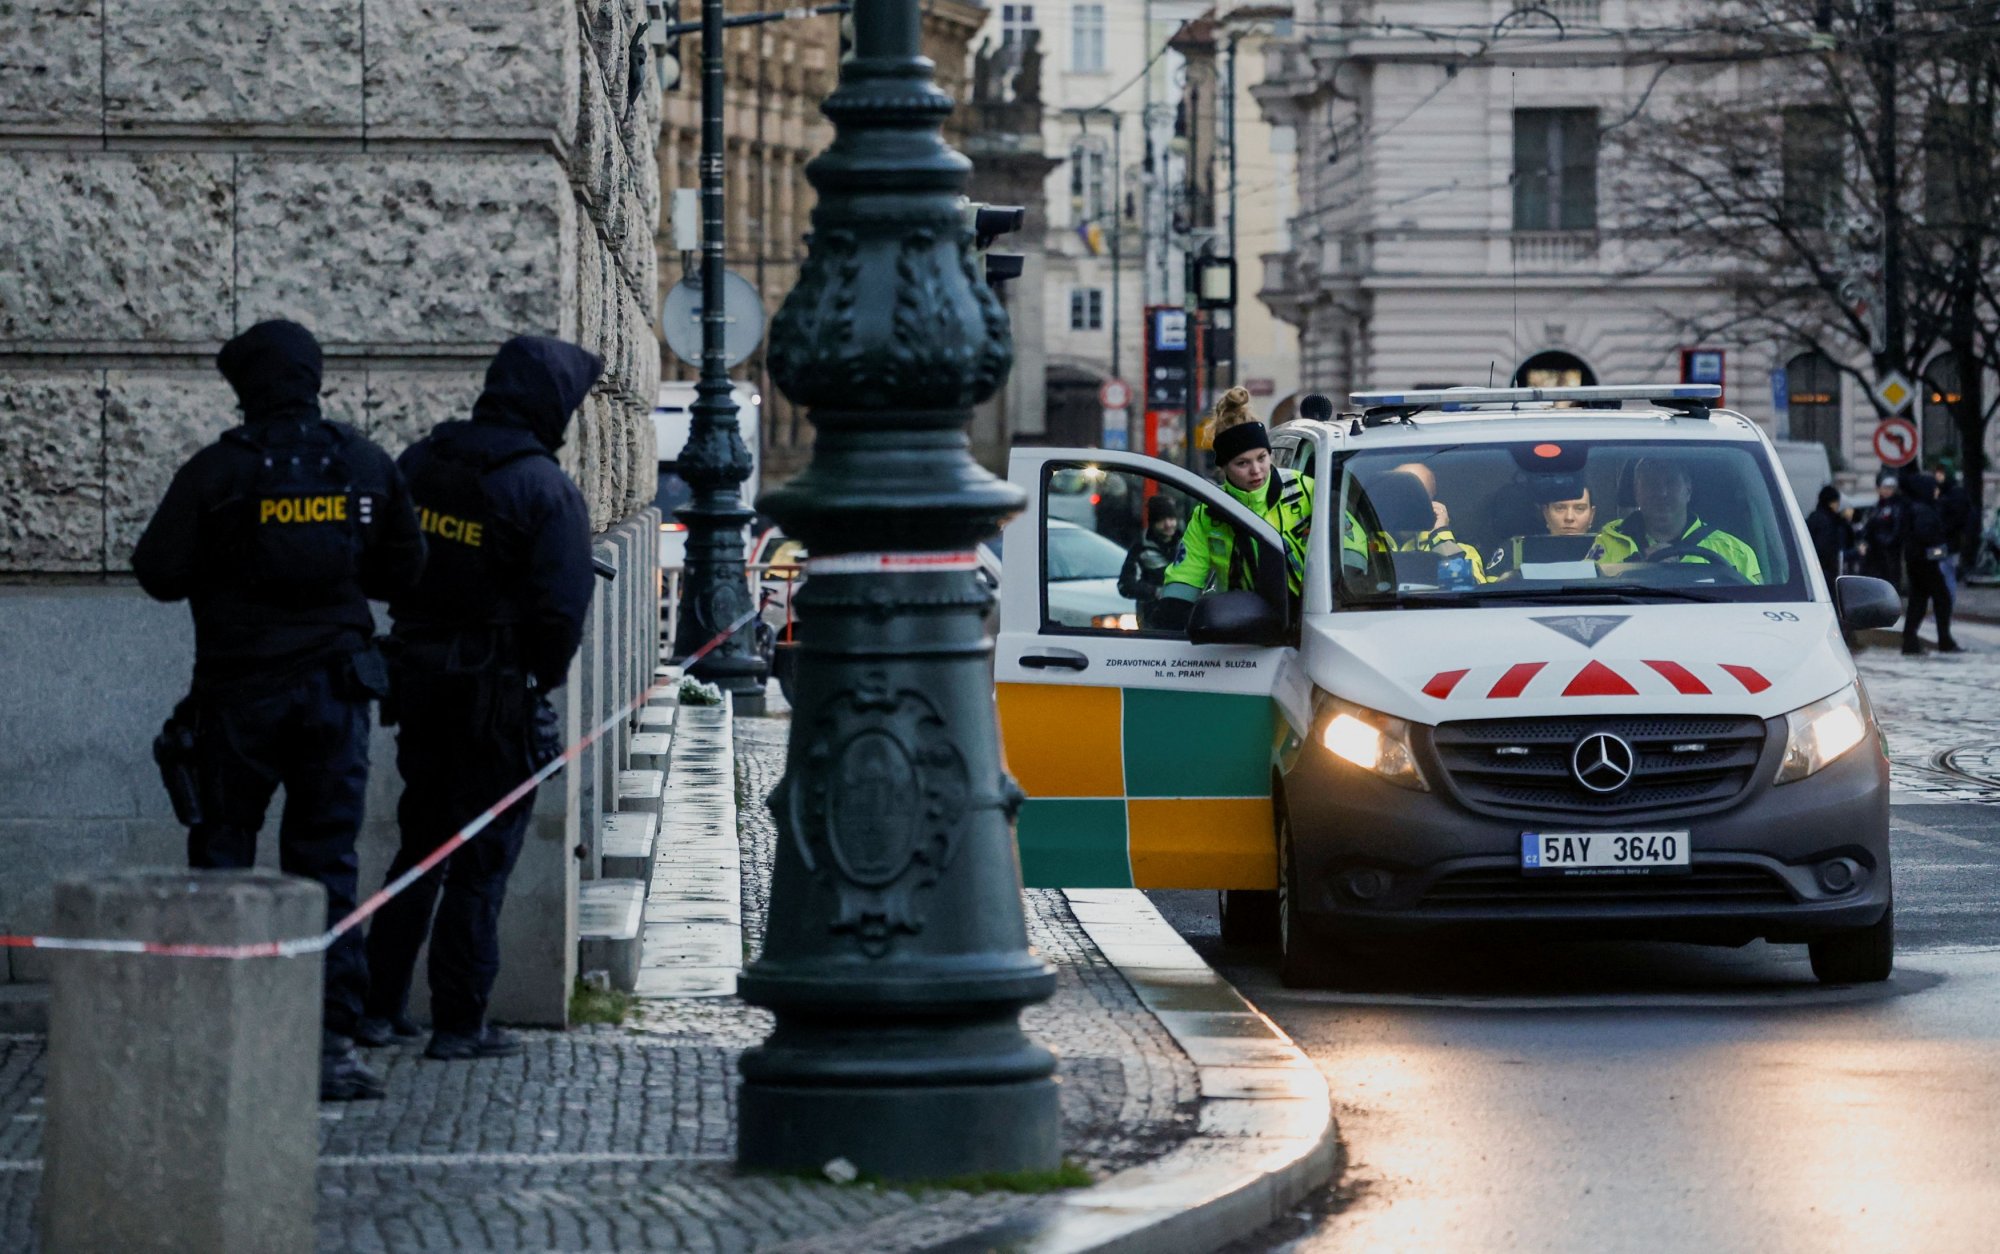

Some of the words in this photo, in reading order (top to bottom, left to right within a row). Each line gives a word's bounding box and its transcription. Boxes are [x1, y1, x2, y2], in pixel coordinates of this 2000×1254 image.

[260, 496, 347, 524] POLICIE
[413, 506, 483, 547] LICIE
[1762, 611, 1800, 622] 99
[1106, 658, 1167, 667] ZDRAVOTNICKÁ
[1171, 658, 1221, 668] ZÁCHRANNÁ
[1225, 659, 1257, 668] SLUŽBA
[1155, 670, 1164, 678] hl.
[1178, 670, 1206, 678] PRAHY
[1545, 837, 1591, 862] 5AY
[1613, 836, 1676, 862] 3640
[1525, 855, 1538, 863] CZ
